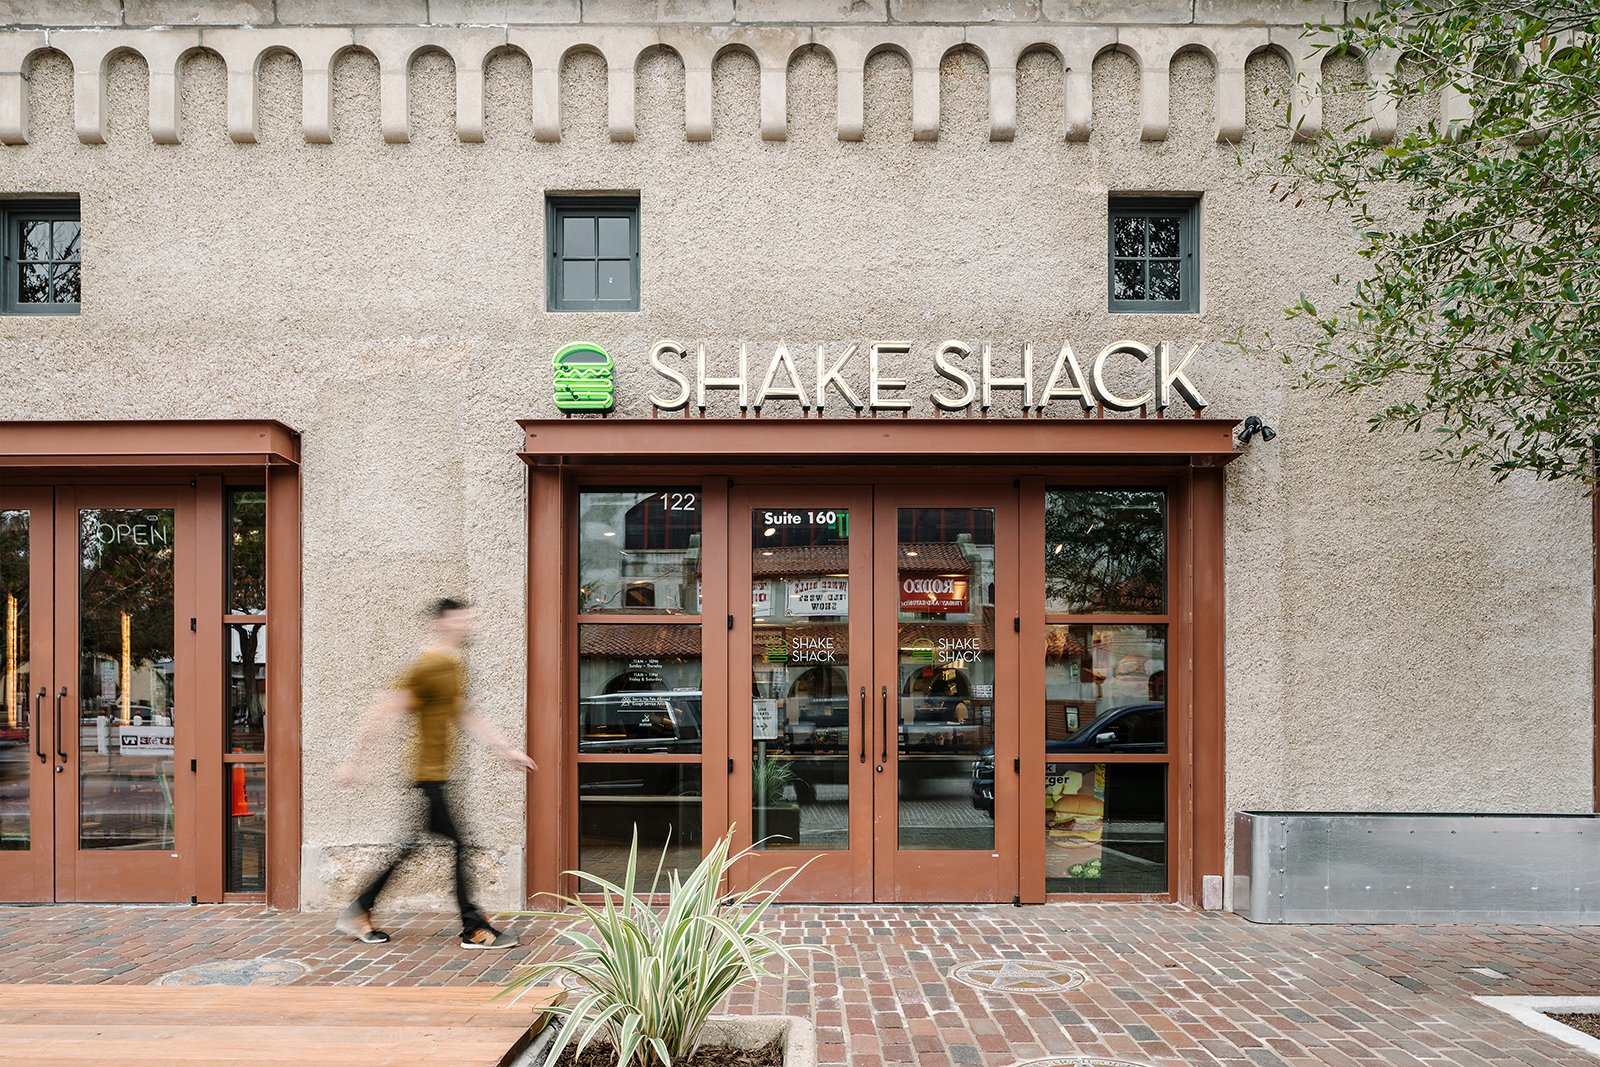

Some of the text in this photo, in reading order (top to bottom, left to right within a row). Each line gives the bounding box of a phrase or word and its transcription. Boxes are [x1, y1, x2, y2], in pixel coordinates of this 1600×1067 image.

[646, 339, 1208, 411] SHAKE SHACK
[660, 492, 696, 511] 122
[764, 511, 802, 525] Suite
[807, 511, 837, 525] 160
[96, 523, 167, 546] OPEN
[792, 637, 834, 649] SHAKE
[938, 637, 980, 650] SHAKE
[792, 650, 836, 662] SHACK
[938, 650, 982, 663] SHACK
[1045, 775, 1070, 788] rger
